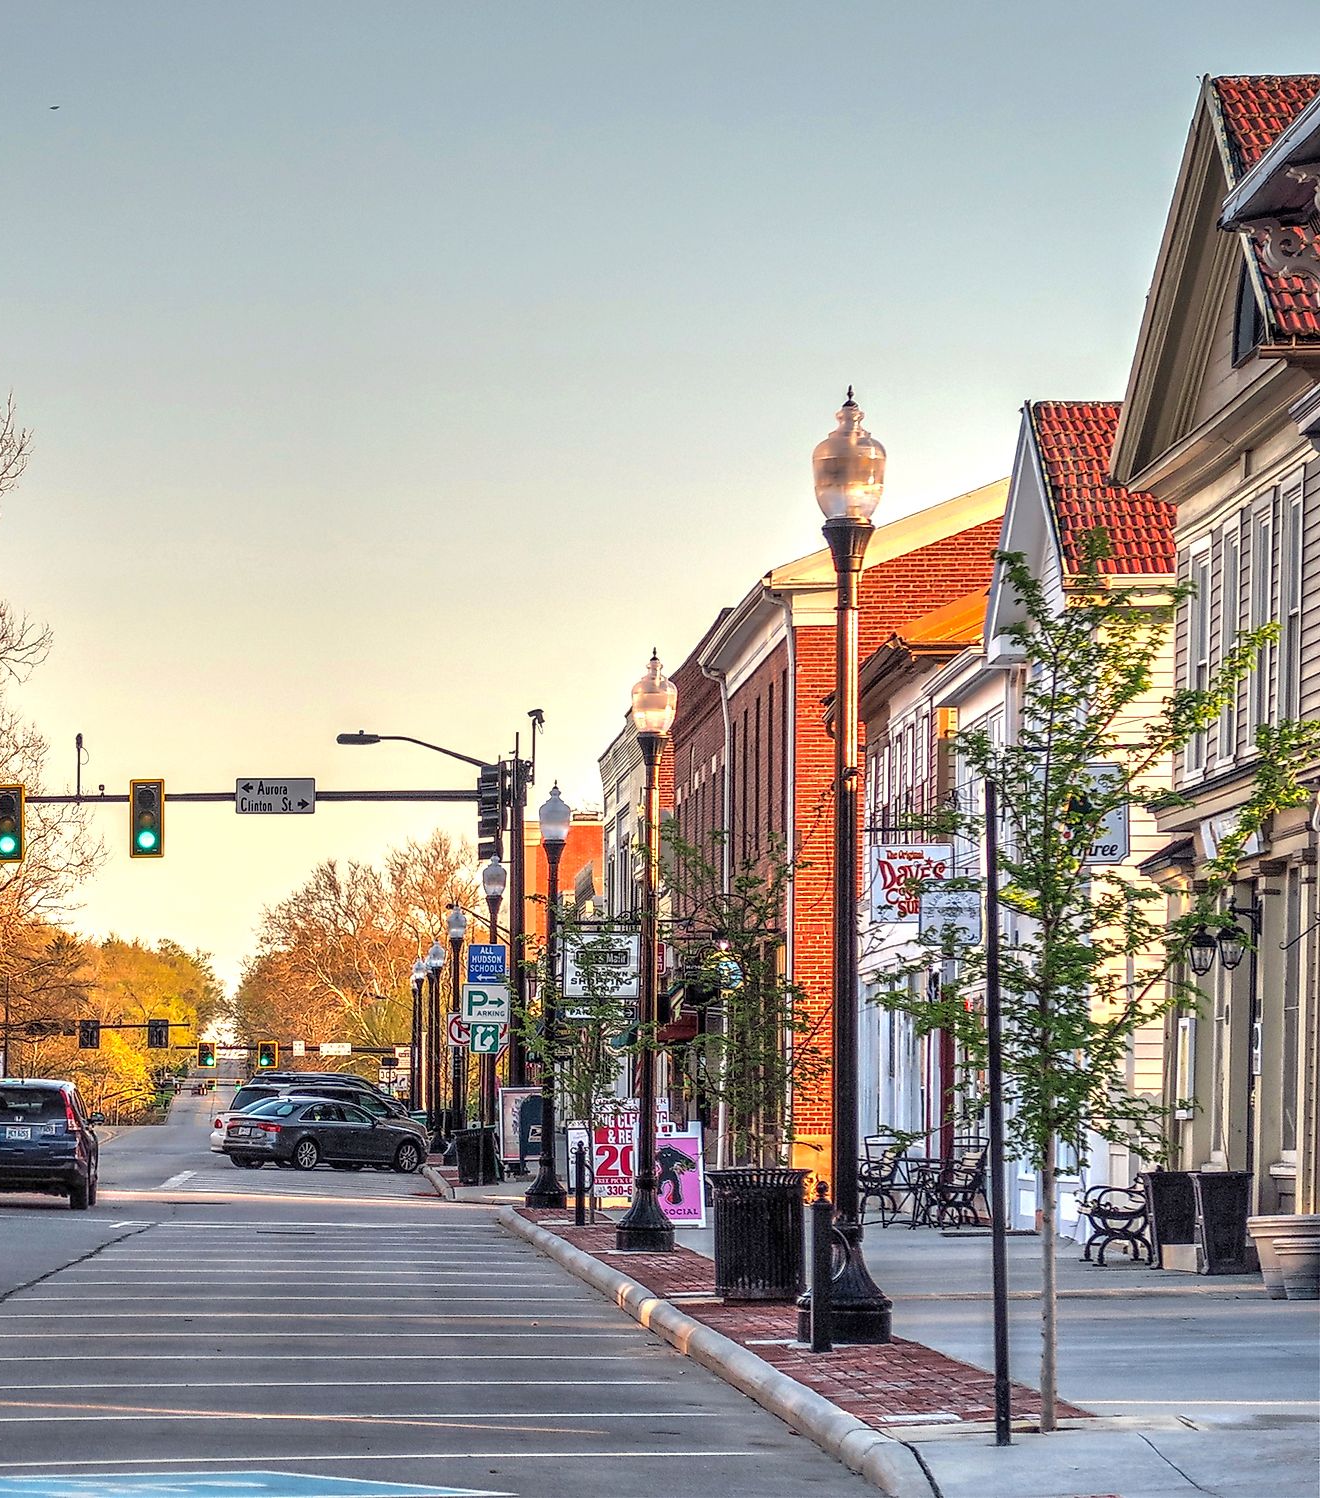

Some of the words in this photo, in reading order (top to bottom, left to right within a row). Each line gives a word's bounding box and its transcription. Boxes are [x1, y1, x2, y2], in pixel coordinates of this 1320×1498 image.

[257, 781, 288, 795] Aurora
[240, 797, 273, 812] Clinton
[281, 797, 293, 811] St.
[480, 946, 494, 955] ALL
[470, 965, 503, 973] SCHOOLS
[607, 1129, 617, 1144] &
[606, 1185, 633, 1196] 330-6
[664, 1207, 699, 1216] SOCIAL
